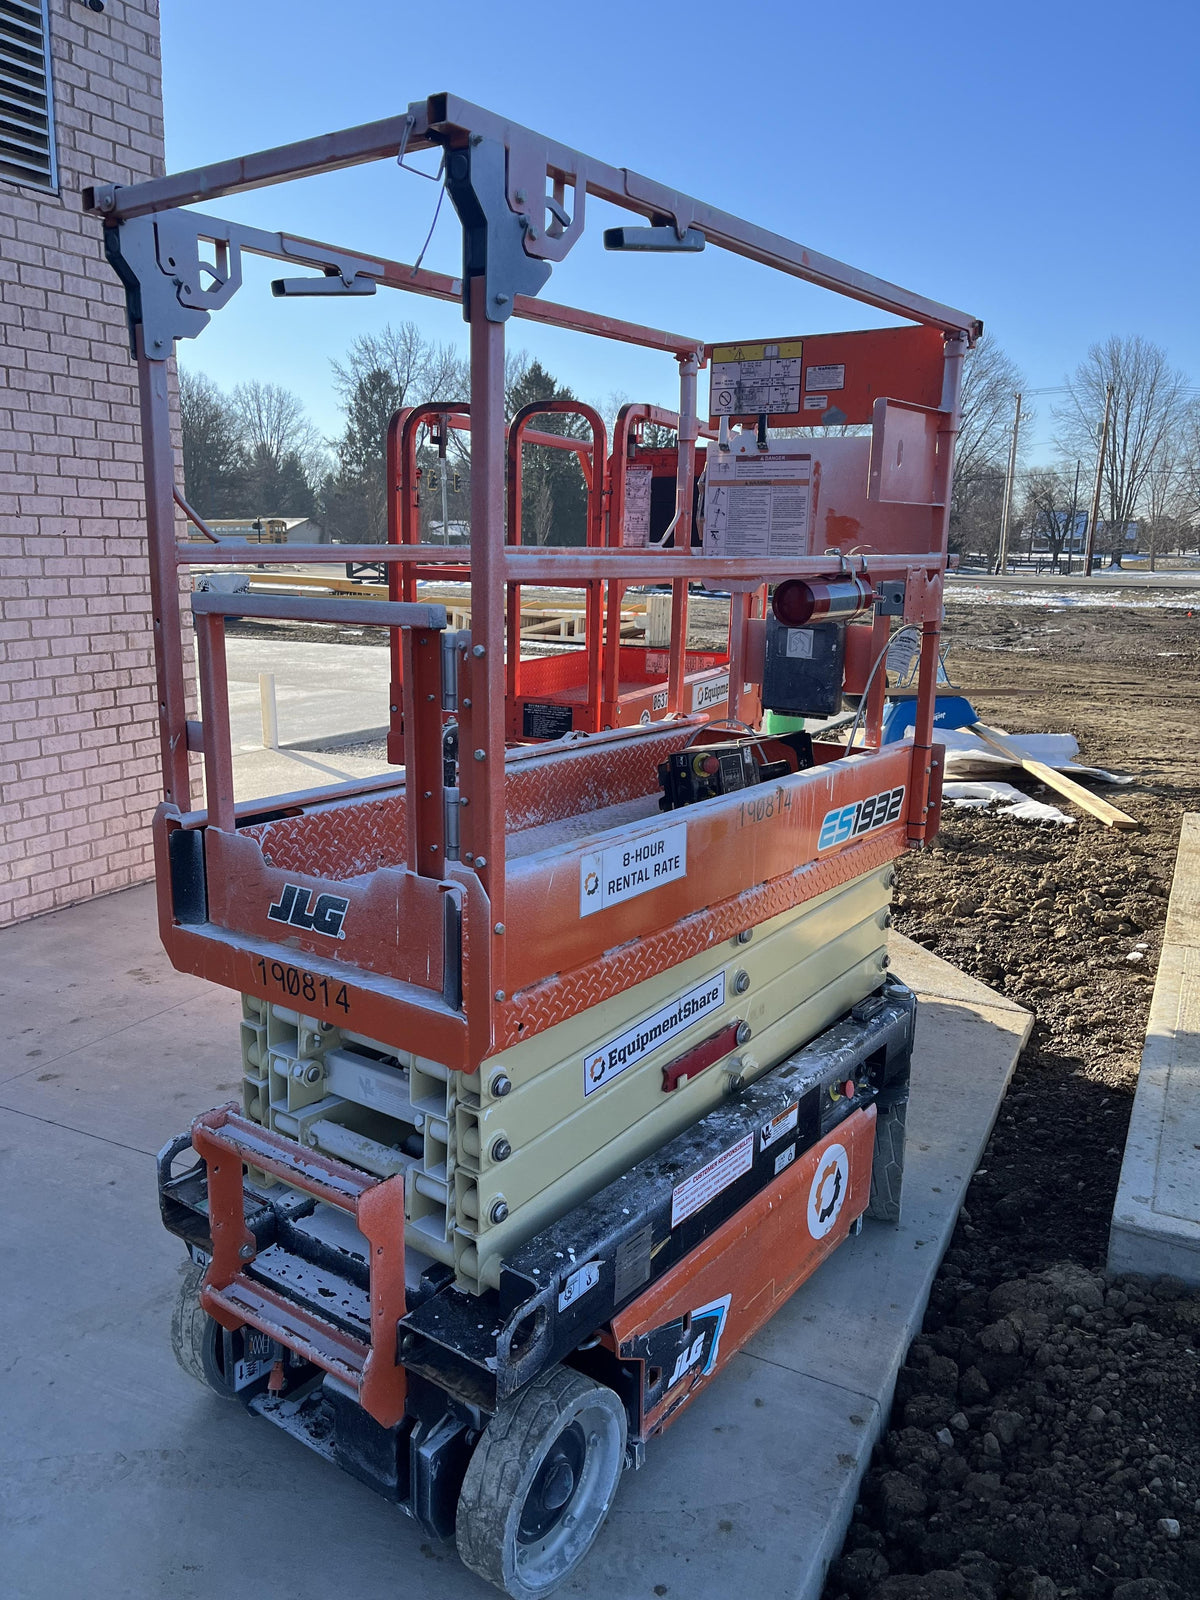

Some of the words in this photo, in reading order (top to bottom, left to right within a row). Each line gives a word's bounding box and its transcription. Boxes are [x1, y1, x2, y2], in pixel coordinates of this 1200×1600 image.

[704, 683, 728, 702] Equipme
[740, 786, 792, 827] 190814
[818, 785, 905, 850] ES1932
[608, 868, 650, 895] RENTAL
[654, 855, 680, 877] RATE
[623, 840, 665, 867] 8-HOUR
[267, 883, 350, 938] JLG
[258, 958, 350, 1013] 190814
[607, 987, 719, 1069] EquipmentShare
[692, 1161, 718, 1183] CUSTOMER
[718, 1136, 753, 1165] RESPONSIBILITY
[667, 1331, 706, 1389] JLG
